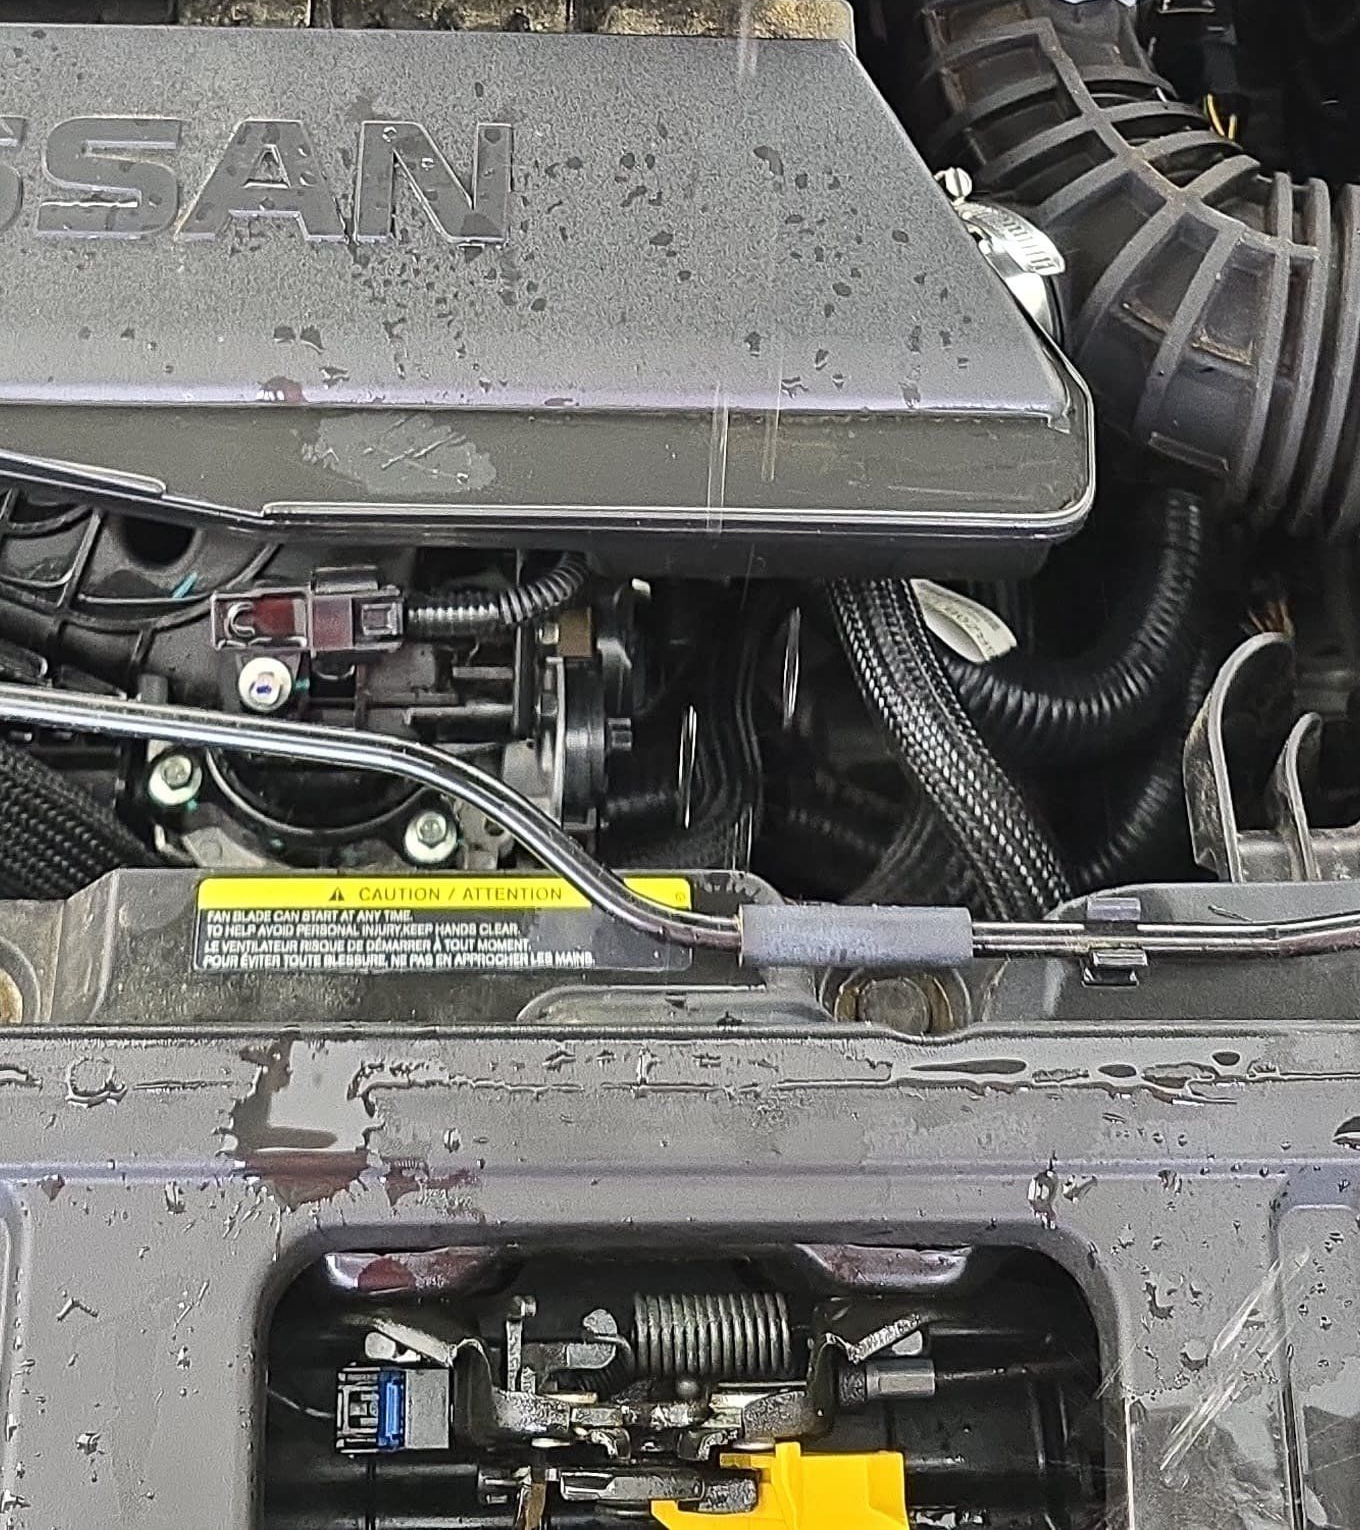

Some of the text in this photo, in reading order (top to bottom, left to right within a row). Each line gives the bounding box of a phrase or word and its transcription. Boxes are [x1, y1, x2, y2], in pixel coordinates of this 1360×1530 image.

[358, 886, 441, 901] CAUTION
[462, 886, 563, 901] ATTENTION
[207, 909, 413, 922] FAN BLADE CAN START AT ANY TIME.
[207, 923, 223, 937] TO
[225, 923, 257, 937] HELP
[258, 923, 294, 937] AVOID
[297, 923, 359, 937] PERSONAL
[435, 923, 476, 937] HANDS
[479, 923, 521, 937] CLEAR.
[204, 934, 531, 953] LE VENTILATEUR RISQUE DE DÉMARRER À TOUT MOMENT.
[203, 954, 238, 968] POUR
[240, 952, 280, 968] ÉVITER
[283, 954, 320, 968] TOUTE
[391, 954, 407, 968] NE
[410, 954, 433, 968] PAS
[436, 954, 453, 968] EN
[454, 954, 528, 968] APPROCHER
[530, 954, 553, 968] LES
[555, 954, 596, 968] MAINS.
